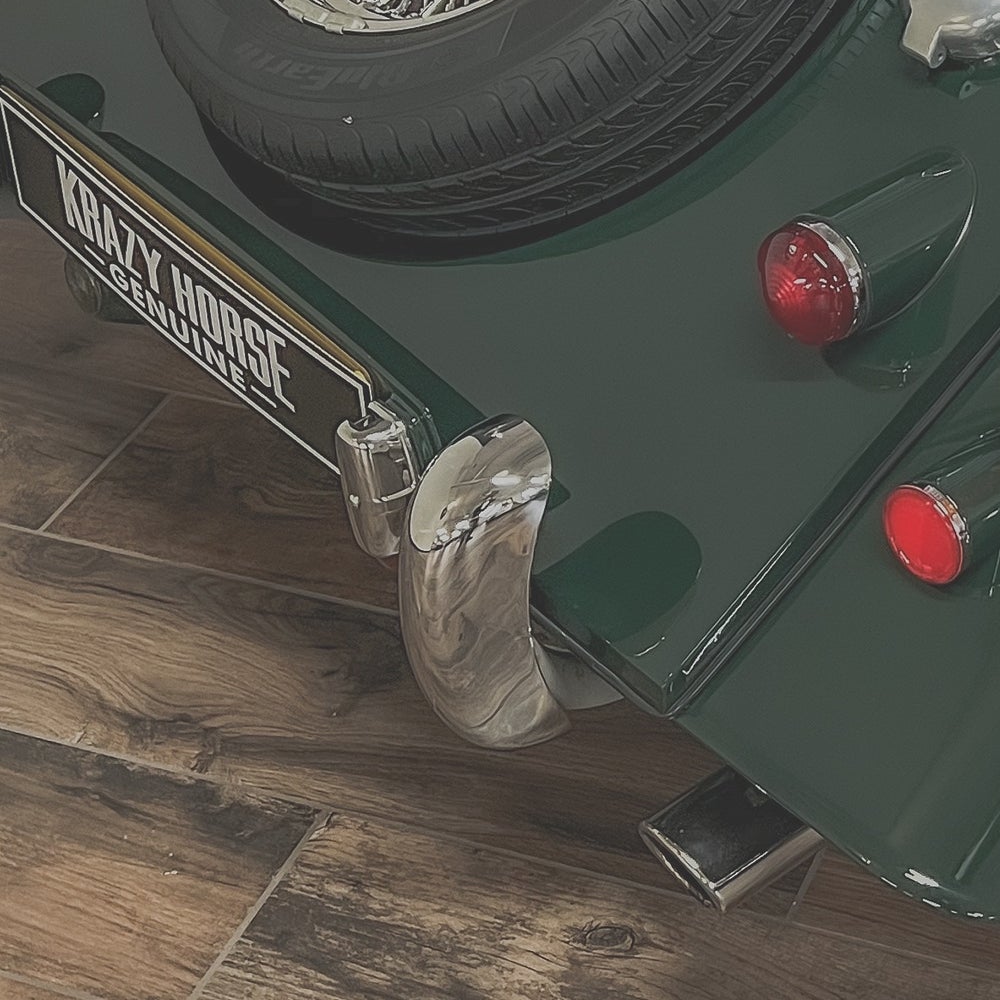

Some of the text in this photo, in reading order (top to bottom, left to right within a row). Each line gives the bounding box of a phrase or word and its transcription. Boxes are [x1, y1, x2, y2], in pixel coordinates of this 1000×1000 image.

[55, 153, 297, 413] KRAZY HORSE
[108, 263, 248, 391] GENUINE
